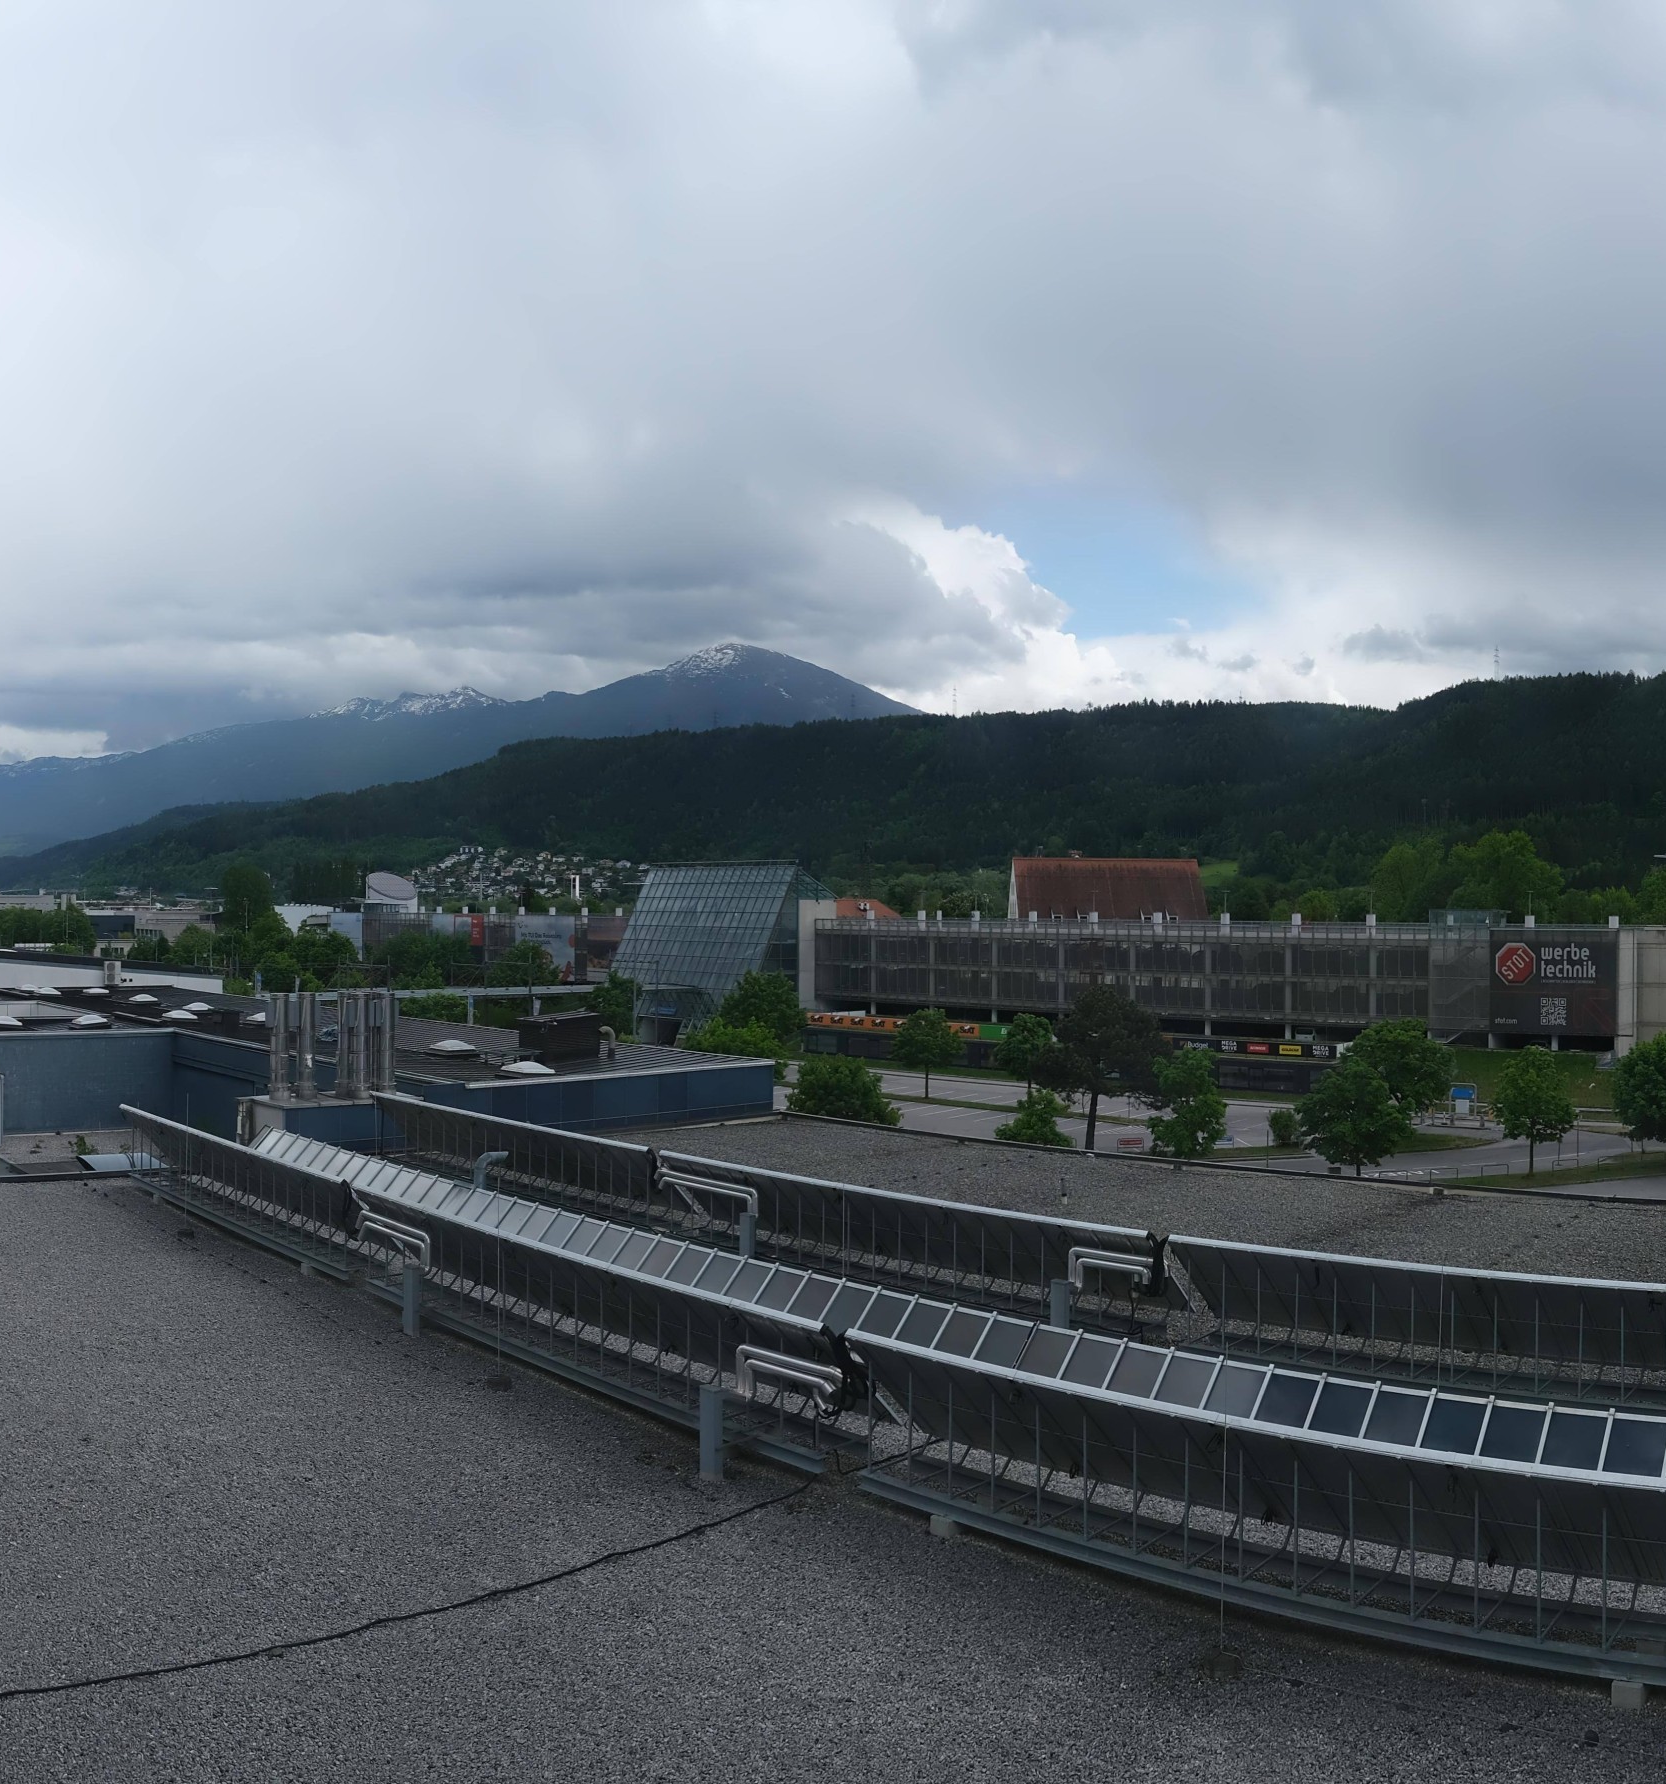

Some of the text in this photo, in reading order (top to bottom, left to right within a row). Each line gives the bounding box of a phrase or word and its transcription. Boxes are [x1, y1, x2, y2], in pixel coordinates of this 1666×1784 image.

[1540, 942, 1590, 960] werbe
[1502, 948, 1530, 980] STOT
[1540, 960, 1596, 978] technik
